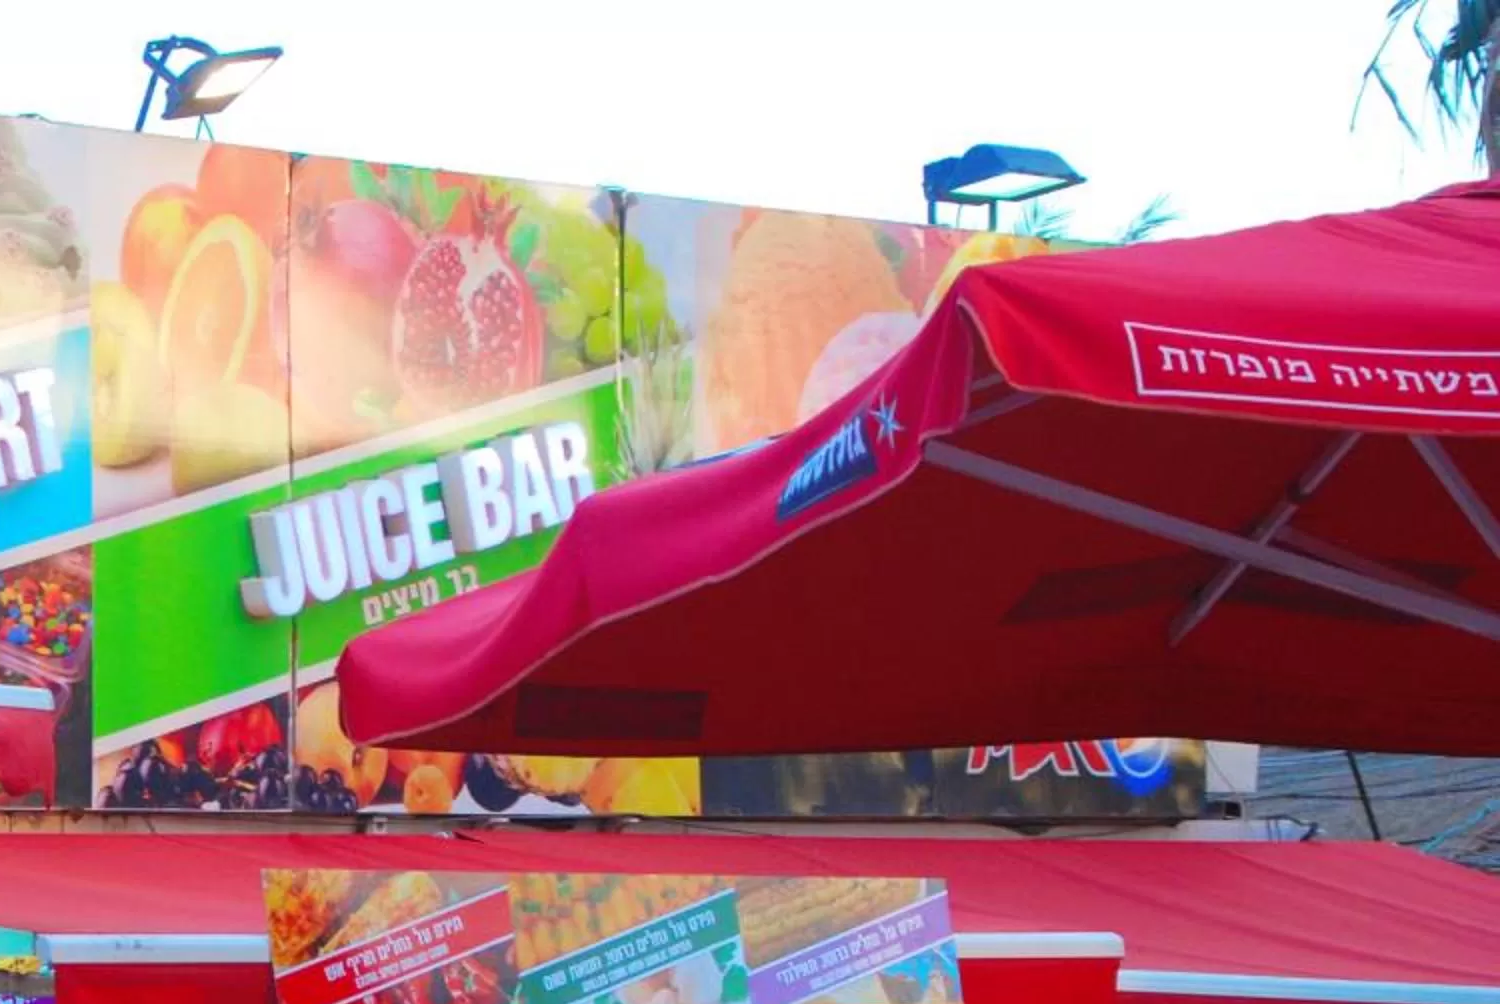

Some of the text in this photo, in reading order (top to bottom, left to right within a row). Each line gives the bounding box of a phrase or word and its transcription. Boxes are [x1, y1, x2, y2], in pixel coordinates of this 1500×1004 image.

[1158, 345, 1500, 397] משתייה מופרזת
[256, 421, 595, 618] JUICE BAR
[362, 565, 480, 626] בר מיצים
